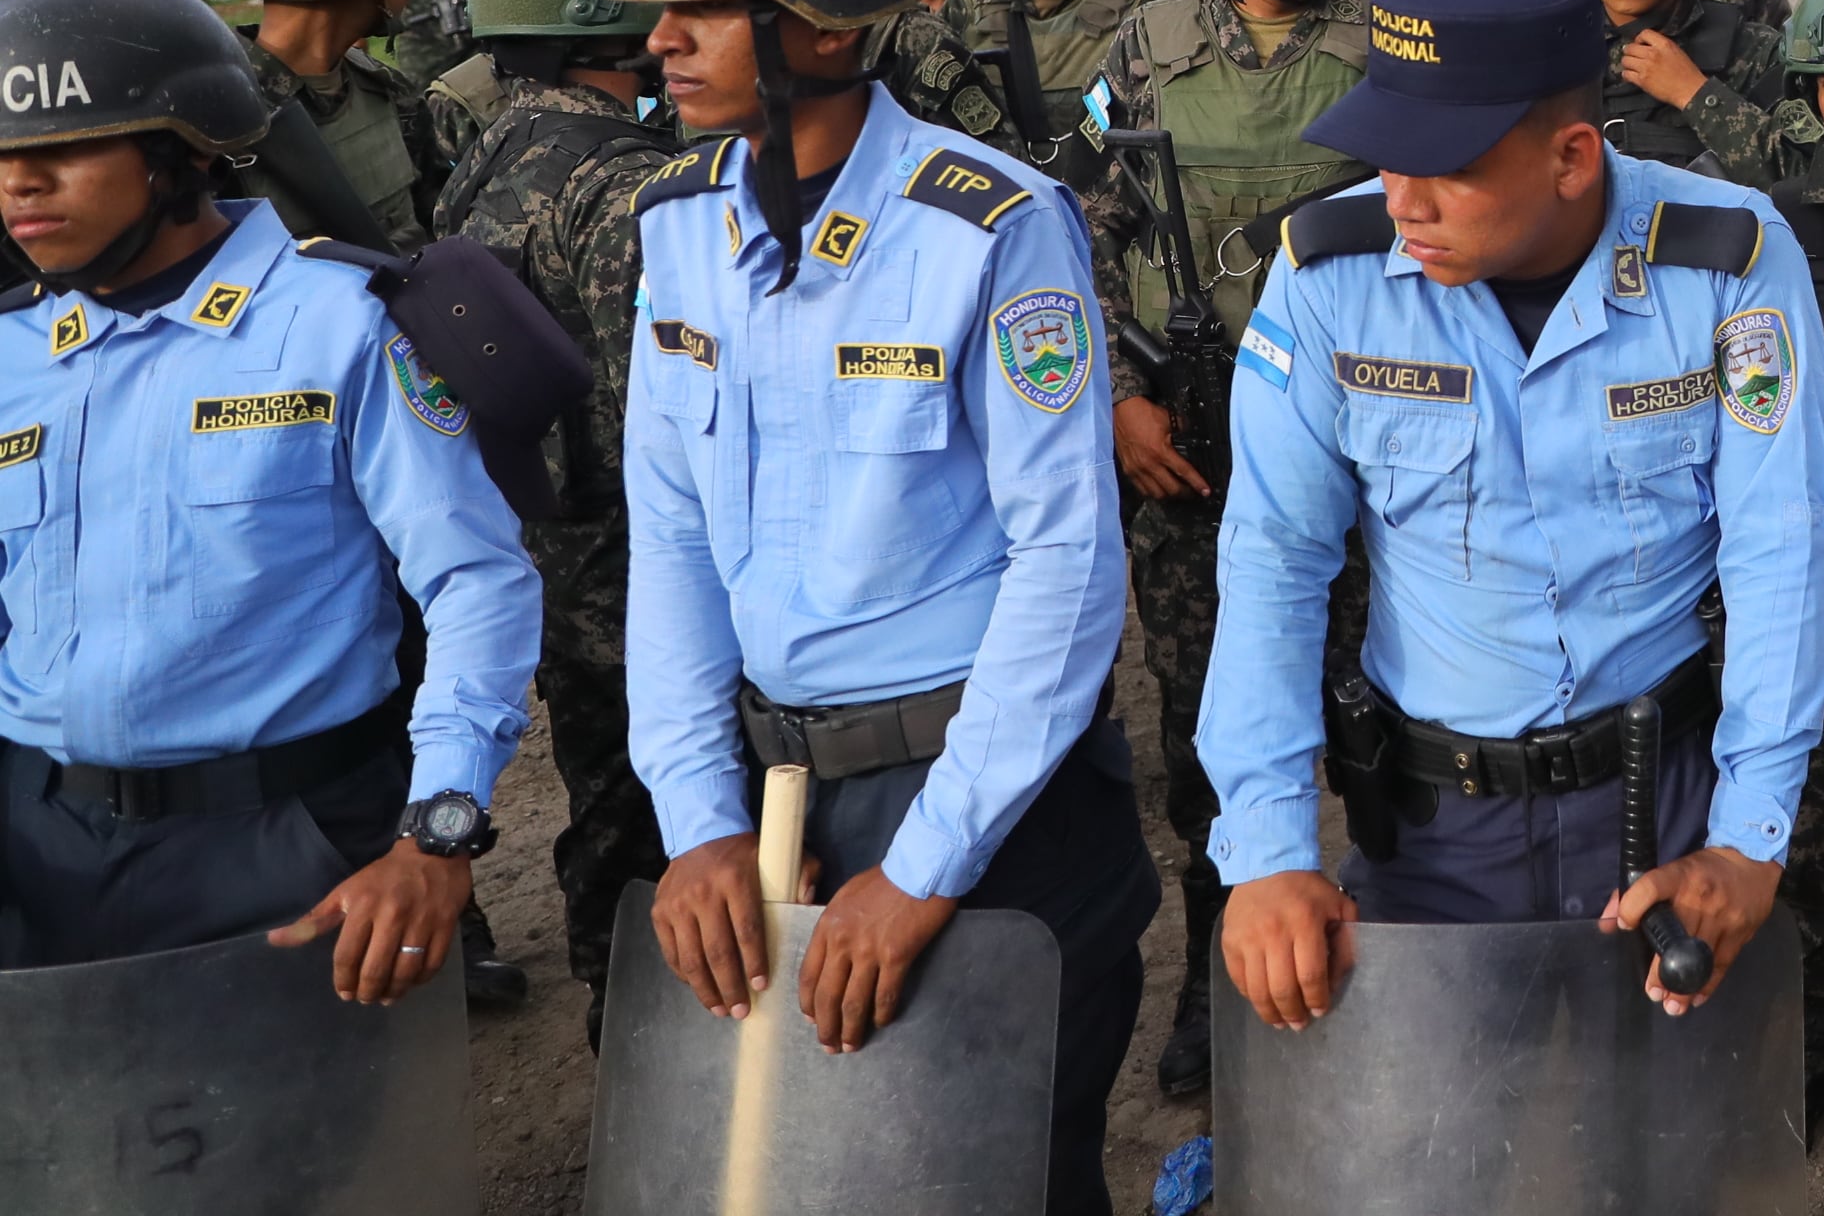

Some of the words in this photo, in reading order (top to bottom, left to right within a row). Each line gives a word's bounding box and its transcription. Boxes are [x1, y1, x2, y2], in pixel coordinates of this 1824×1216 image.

[1372, 5, 1434, 37] POLICIA
[3, 60, 92, 112] CIA
[652, 153, 700, 184] ITP
[934, 164, 992, 192] ITP
[999, 296, 1076, 326] HONDURAS
[1714, 314, 1772, 344] HONDURAS
[1013, 374, 1056, 405] POLICIA
[1055, 359, 1087, 404] NACIONAL
[1354, 363, 1441, 393] OYUELA
[1634, 372, 1715, 401] POLICIA
[221, 394, 308, 414] POLICIA
[412, 397, 450, 429] POLICIA
[1726, 394, 1769, 429] POLICIA
[1771, 371, 1792, 425] NACIONAL
[201, 405, 326, 429] HONDURAS
